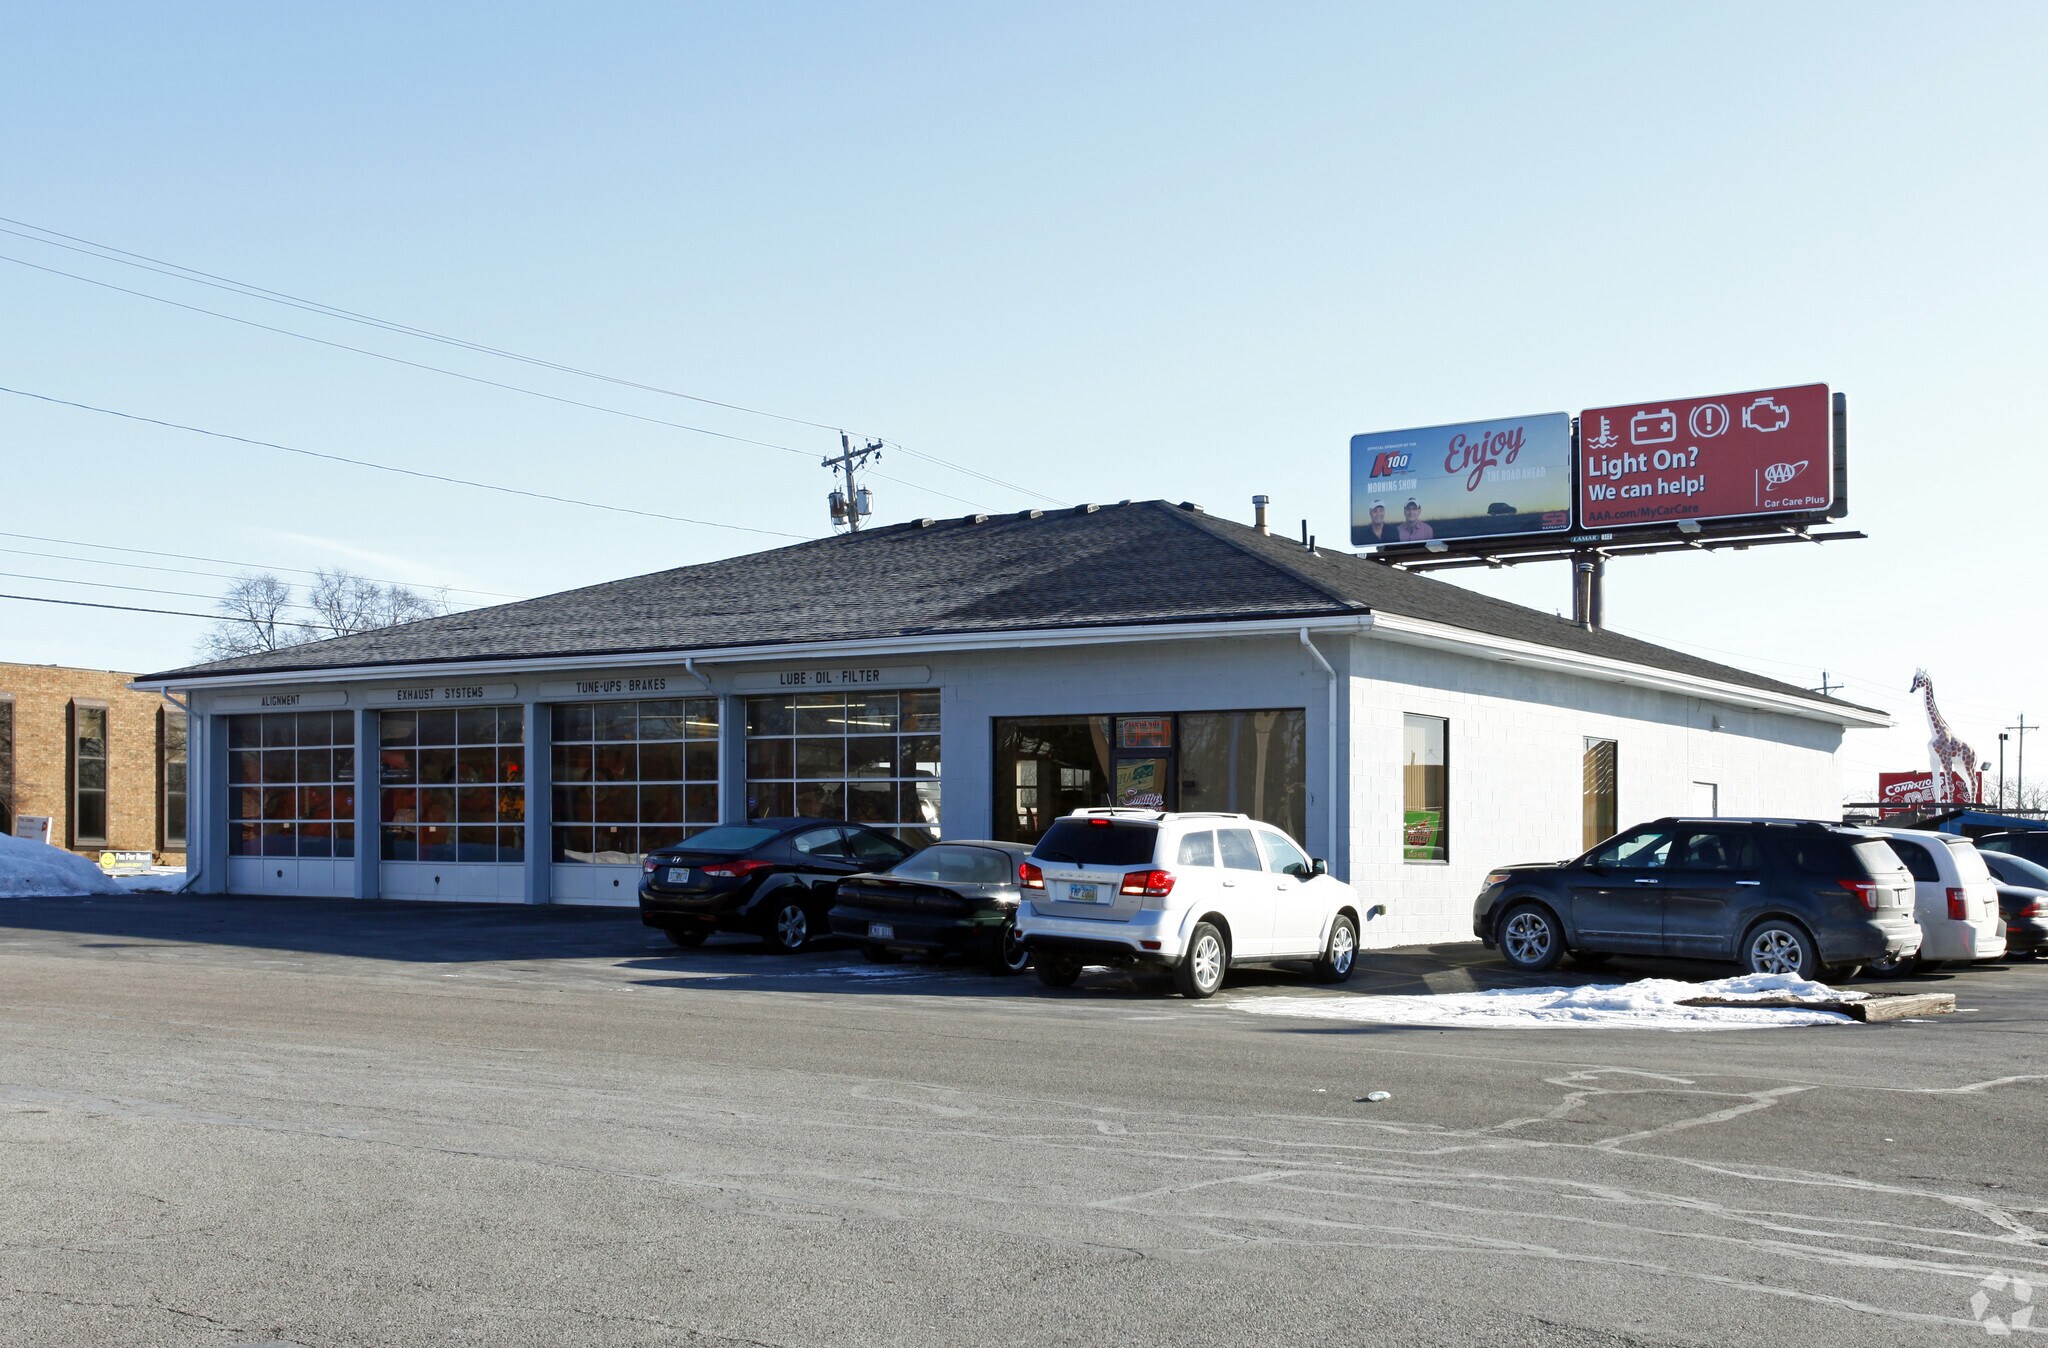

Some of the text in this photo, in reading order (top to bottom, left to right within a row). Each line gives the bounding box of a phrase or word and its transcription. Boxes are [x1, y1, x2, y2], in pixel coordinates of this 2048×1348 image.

[1444, 426, 1526, 492] Enjoy
[1588, 446, 1699, 480] Light On?
[1487, 466, 1546, 483] THE ROAD AHEAD
[1367, 478, 1417, 493] MORNING SHOW
[1588, 474, 1705, 501] We can help!
[1764, 496, 1825, 508] Car Care Plus
[1588, 504, 1699, 521] AAA.com/MyCarCare
[629, 678, 666, 691] BRAKES
[780, 669, 880, 685] LUBE OIL FILTER
[261, 694, 300, 706] ALIGNMENT
[397, 687, 483, 701] EXHAUST SYSTEMS
